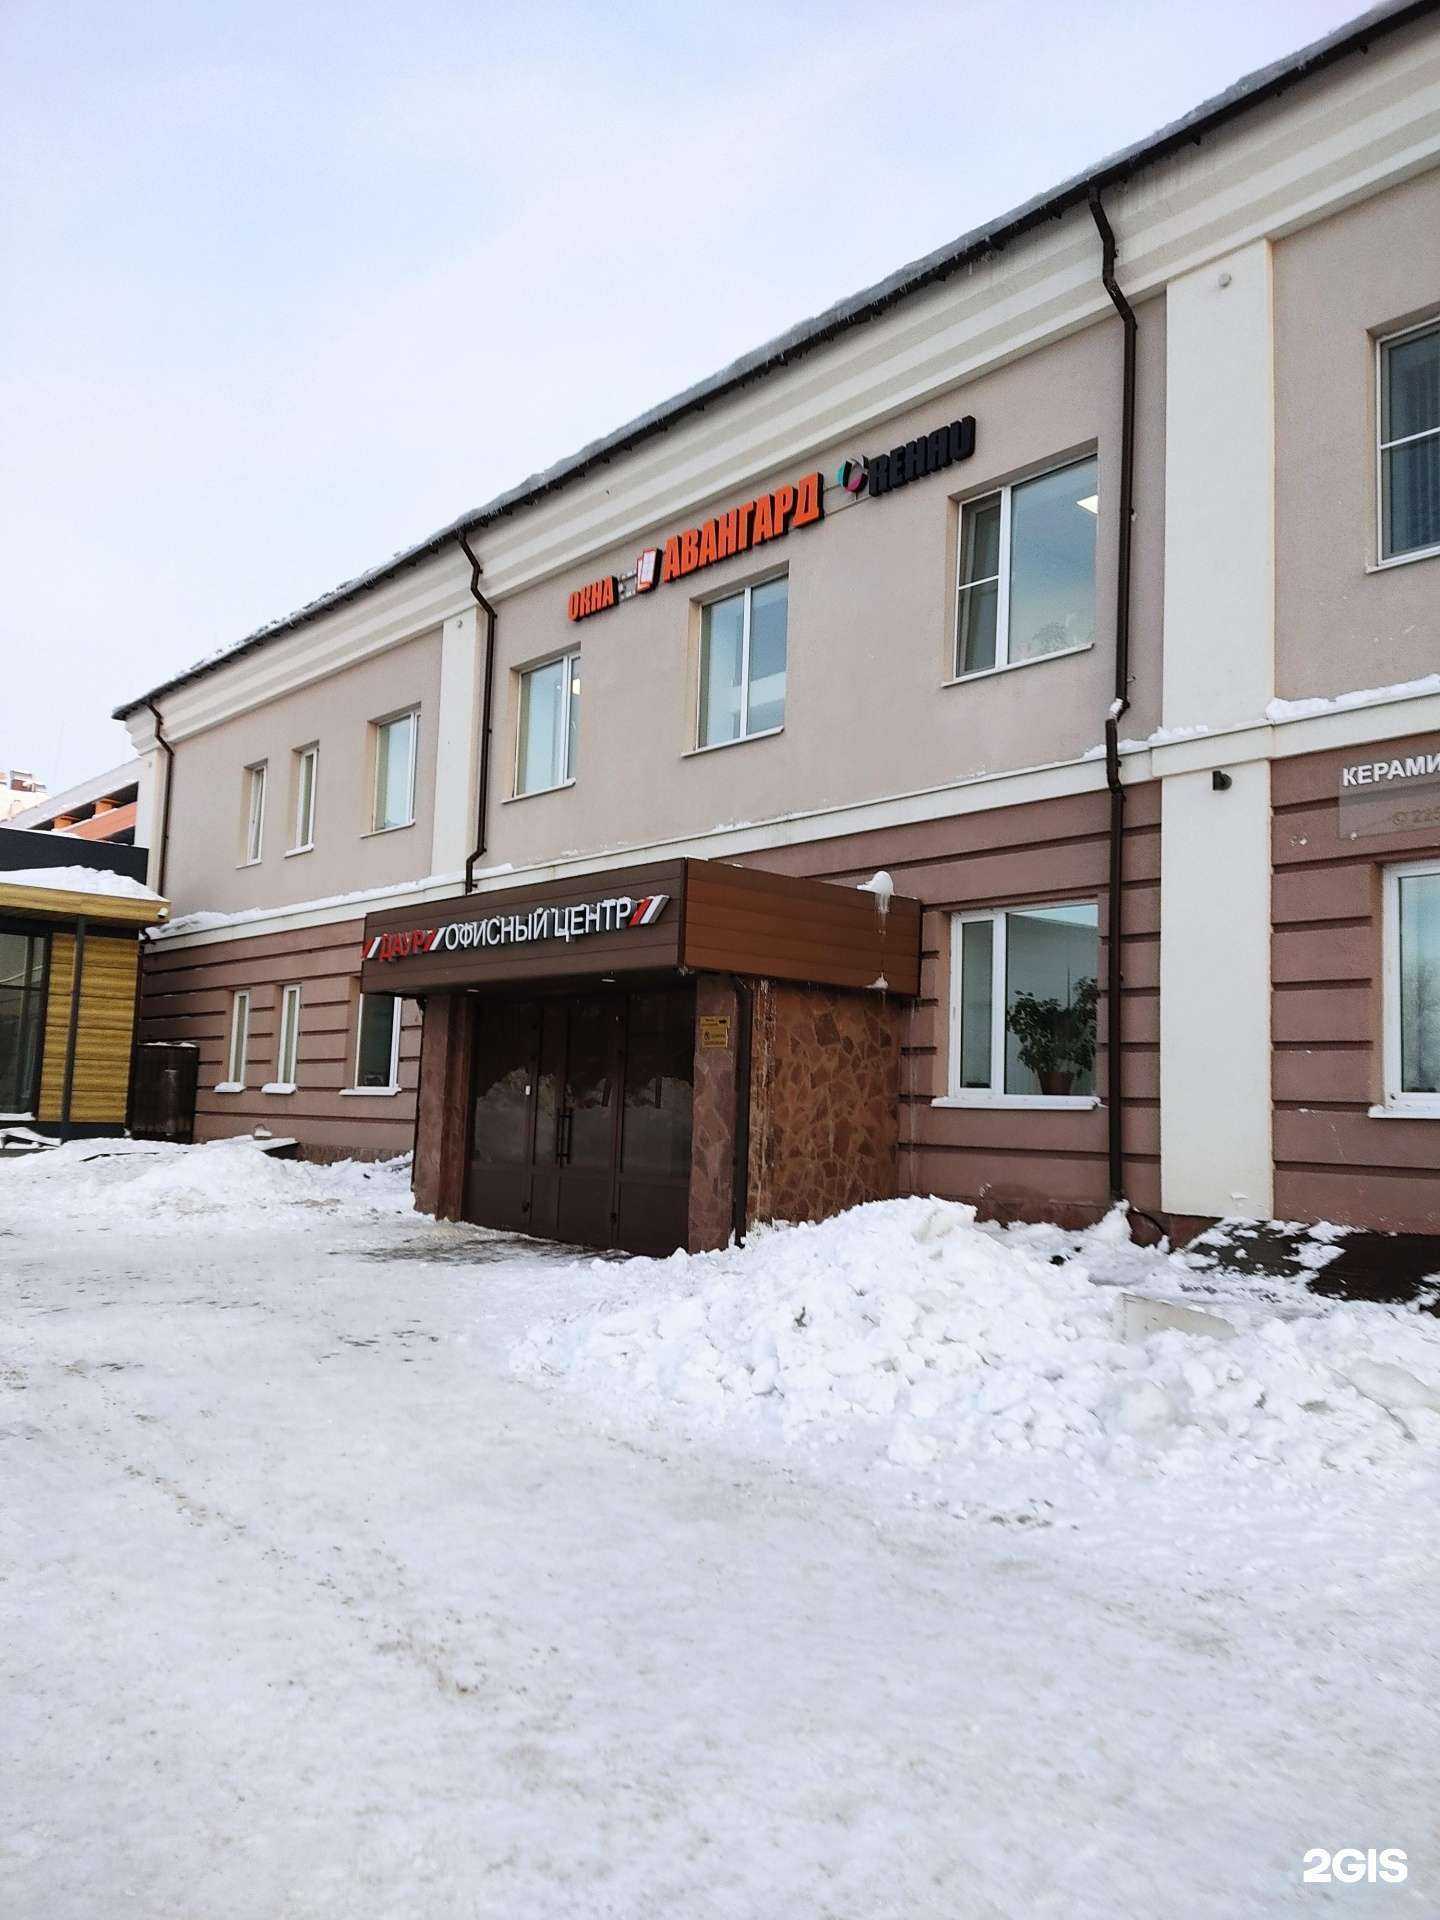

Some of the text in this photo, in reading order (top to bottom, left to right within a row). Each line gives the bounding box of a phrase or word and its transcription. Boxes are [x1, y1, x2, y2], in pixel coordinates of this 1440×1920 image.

[869, 415, 976, 497] REHAU
[568, 472, 824, 622] ОКНА АВАНГАРД
[445, 906, 549, 950] ОФИСНЫЙ
[553, 896, 634, 943] ЦЕНТР
